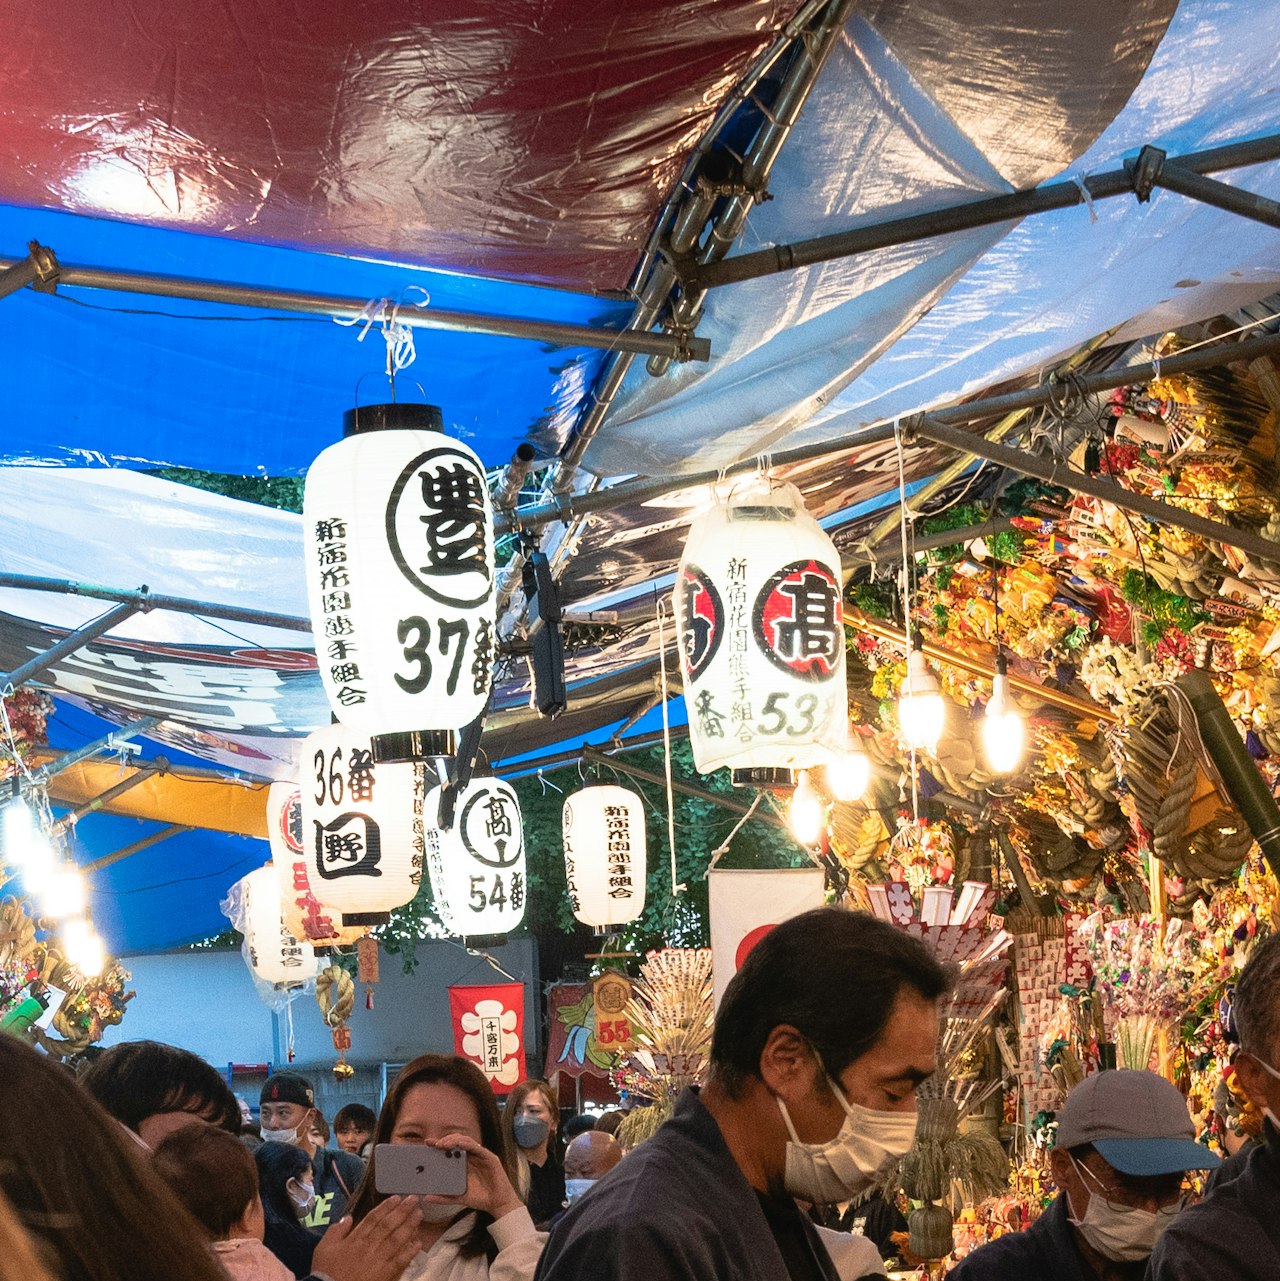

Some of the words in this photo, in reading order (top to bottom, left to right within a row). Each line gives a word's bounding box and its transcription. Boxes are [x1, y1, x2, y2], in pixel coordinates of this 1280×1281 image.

[315, 518, 369, 706] 新宿花園熊手組合
[725, 557, 757, 742] 新宿花園熊手組合
[604, 805, 635, 899] 新宿花園熊手組合
[485, 1020, 500, 1068] 千客万来
[599, 1019, 631, 1044] 55
